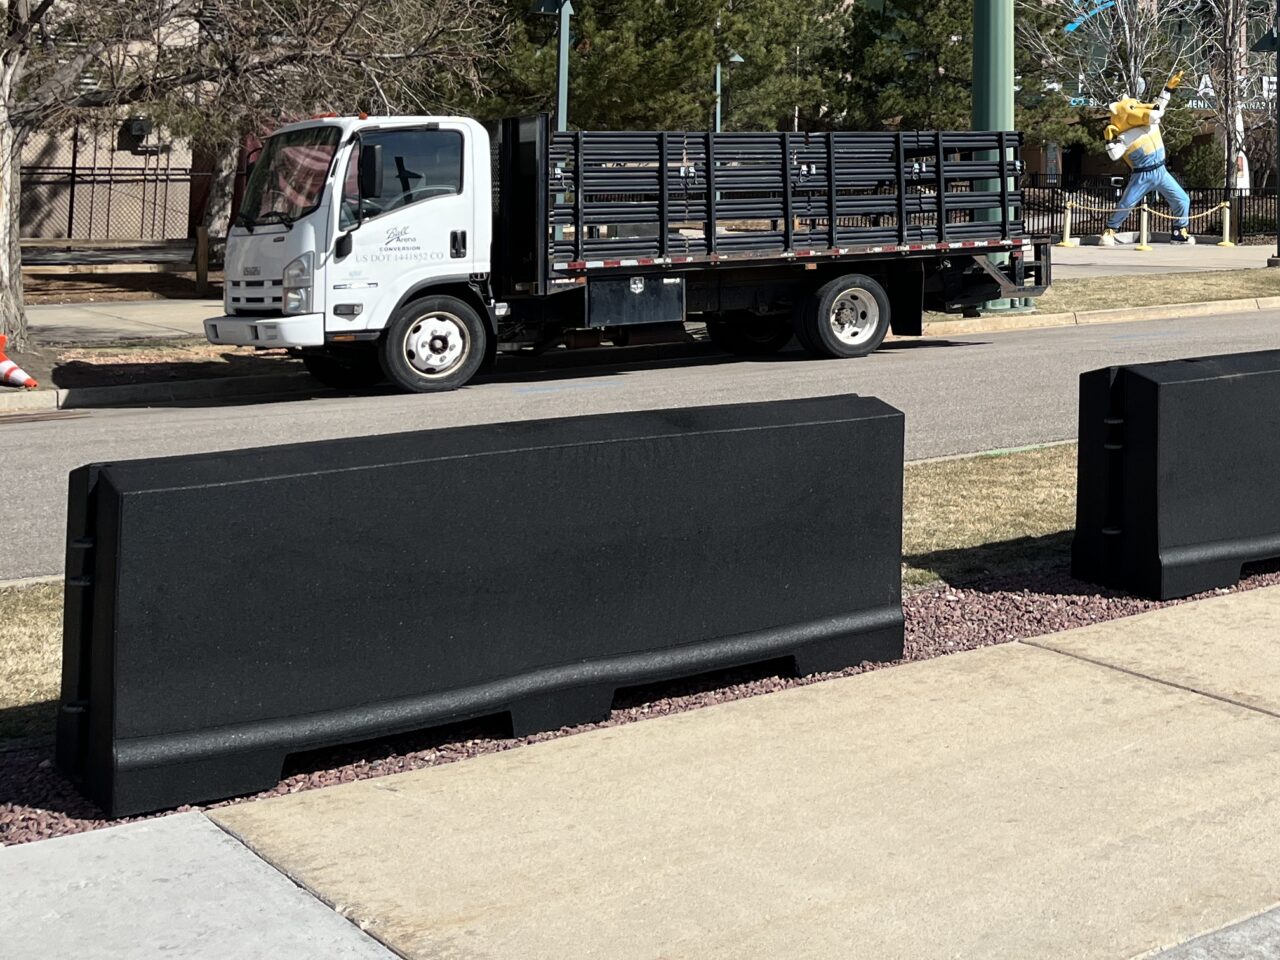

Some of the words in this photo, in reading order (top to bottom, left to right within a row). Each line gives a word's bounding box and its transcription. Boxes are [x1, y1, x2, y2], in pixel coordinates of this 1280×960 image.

[355, 254, 368, 263] US
[371, 254, 391, 262] DOT
[430, 251, 444, 260] CO
